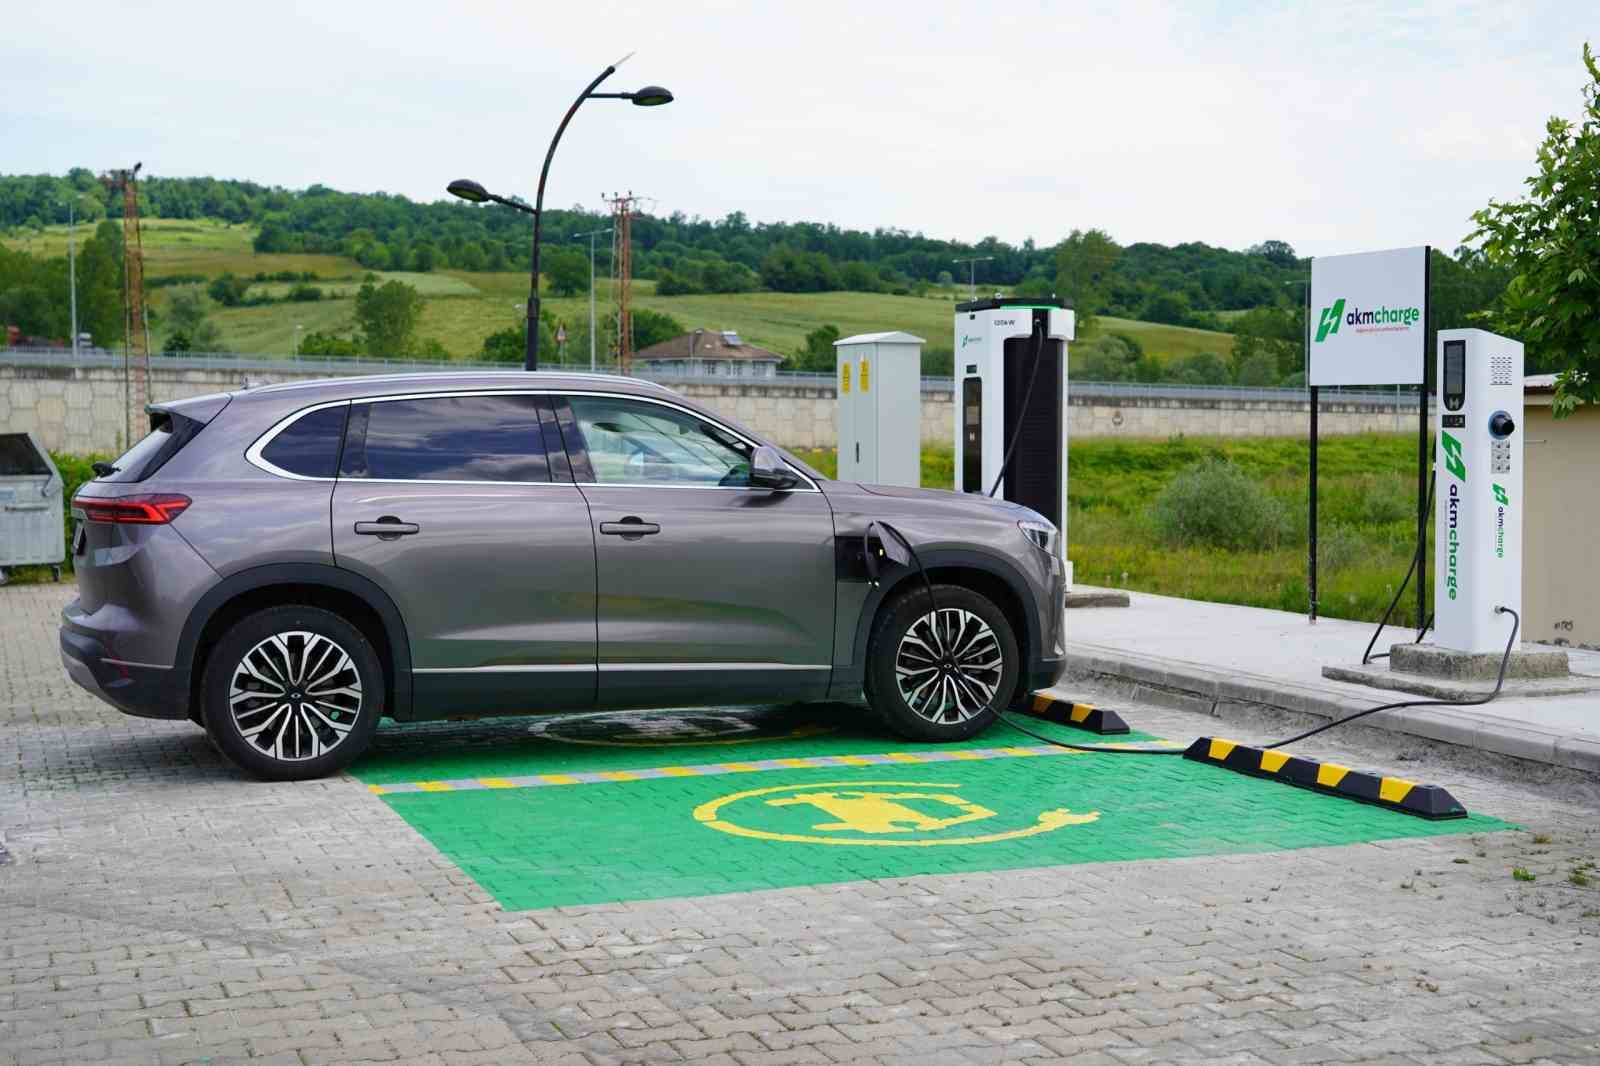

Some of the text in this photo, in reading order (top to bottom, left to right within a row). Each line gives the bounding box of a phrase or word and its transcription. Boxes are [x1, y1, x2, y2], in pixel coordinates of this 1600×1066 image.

[1346, 306, 1419, 325] akmcharge
[1447, 484, 1460, 600] akmcharge
[1496, 506, 1504, 558] akmcharge
